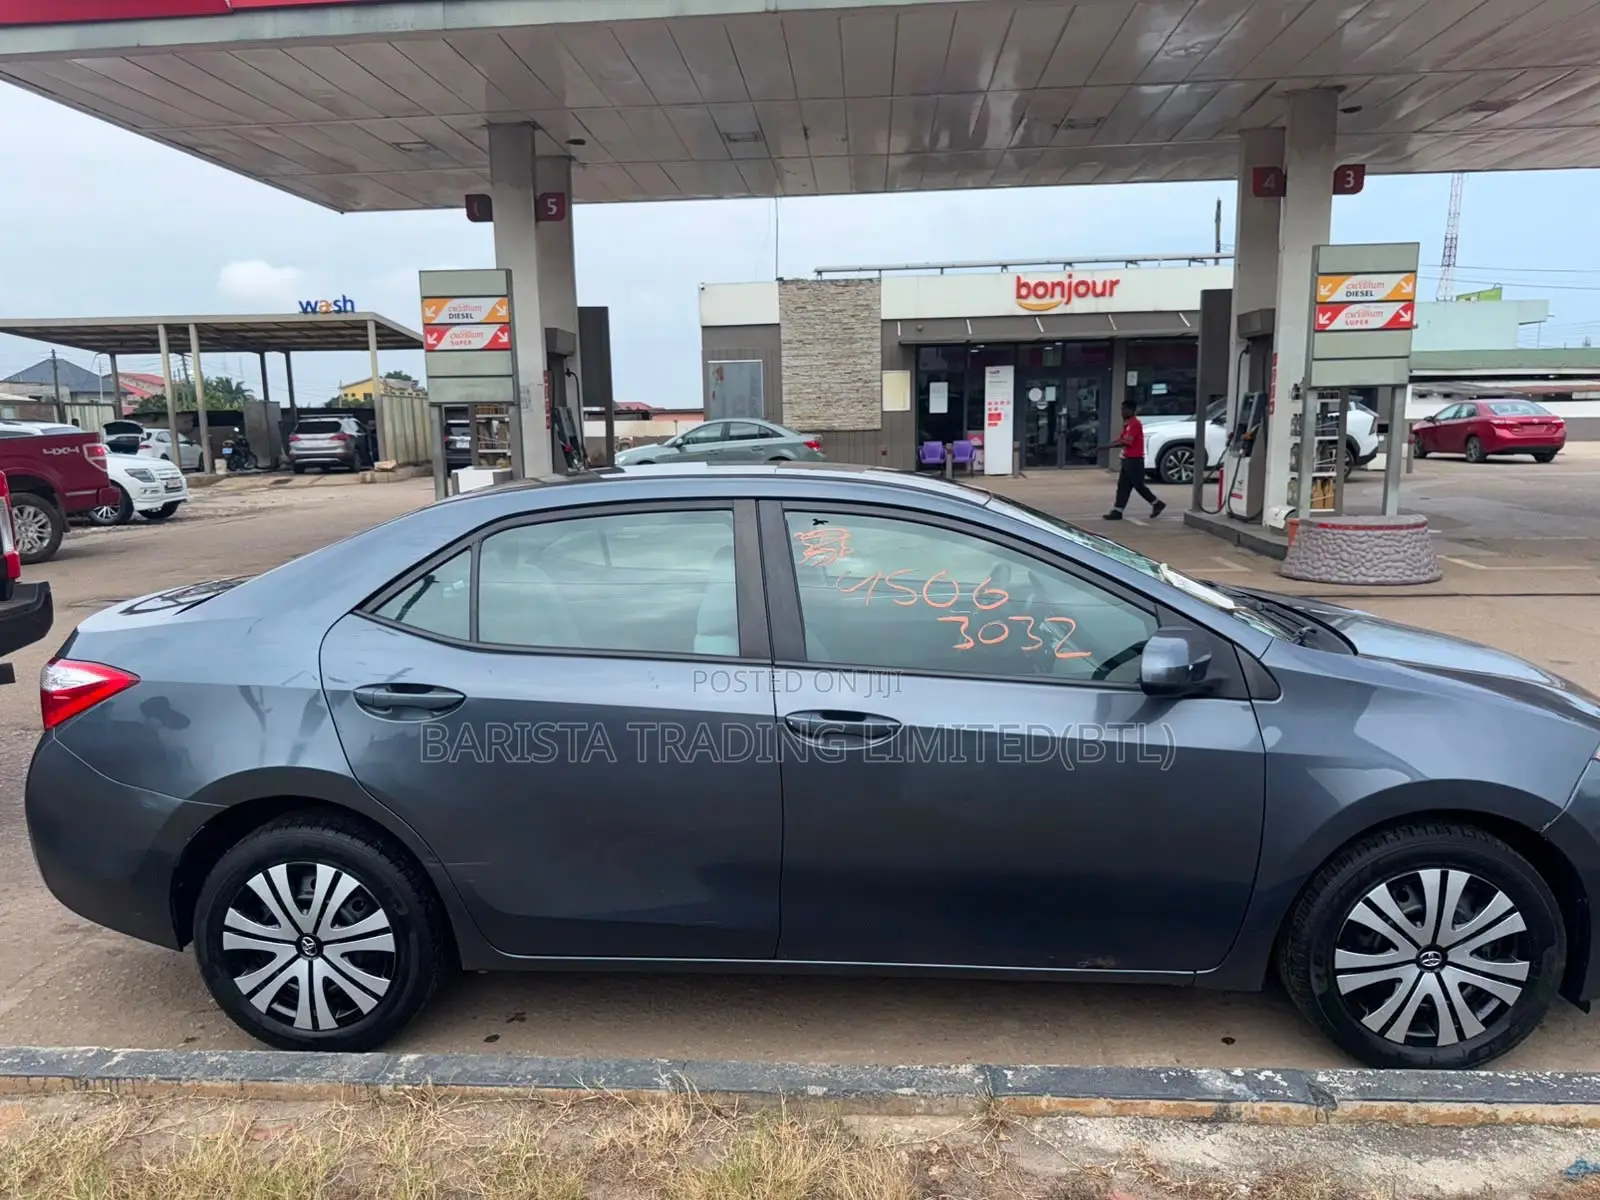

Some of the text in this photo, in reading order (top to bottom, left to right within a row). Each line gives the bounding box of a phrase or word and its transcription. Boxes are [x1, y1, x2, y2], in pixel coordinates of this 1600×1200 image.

[1263, 173, 1276, 191] 4
[1343, 170, 1355, 188] 3
[547, 198, 558, 216] 5
[1015, 273, 1121, 305] bonjour
[1345, 290, 1375, 298] DIESEL
[298, 294, 356, 314] wash
[448, 312, 475, 320] DIESEL
[1344, 319, 1370, 327] SUPER
[937, 615, 1093, 660] 3032
